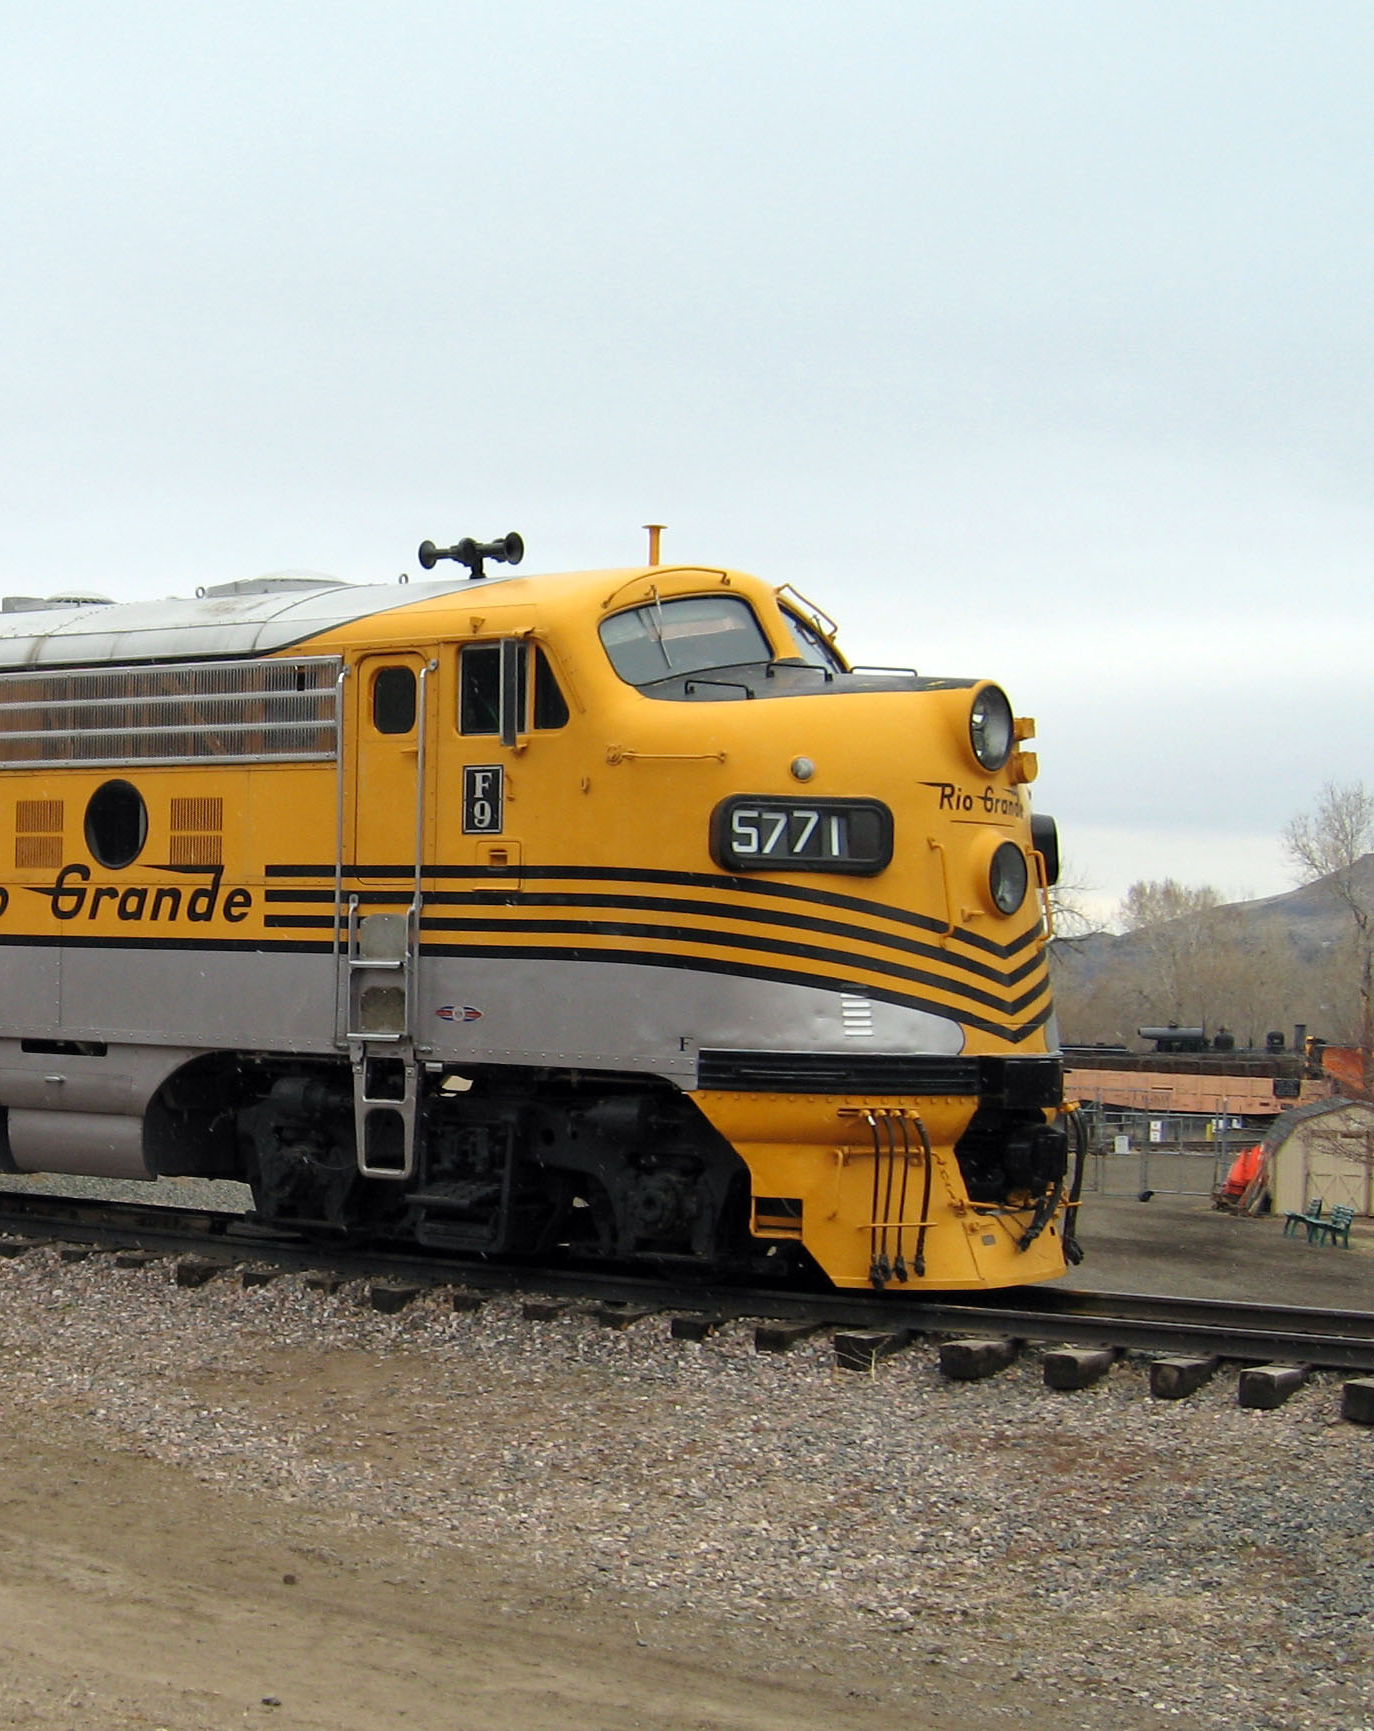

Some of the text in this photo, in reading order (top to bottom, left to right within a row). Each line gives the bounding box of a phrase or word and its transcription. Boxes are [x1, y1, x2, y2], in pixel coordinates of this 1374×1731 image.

[474, 772, 492, 798] F
[916, 781, 973, 811] Rio
[473, 800, 492, 828] 9
[731, 809, 840, 856] 5771
[20, 863, 252, 922] Grande
